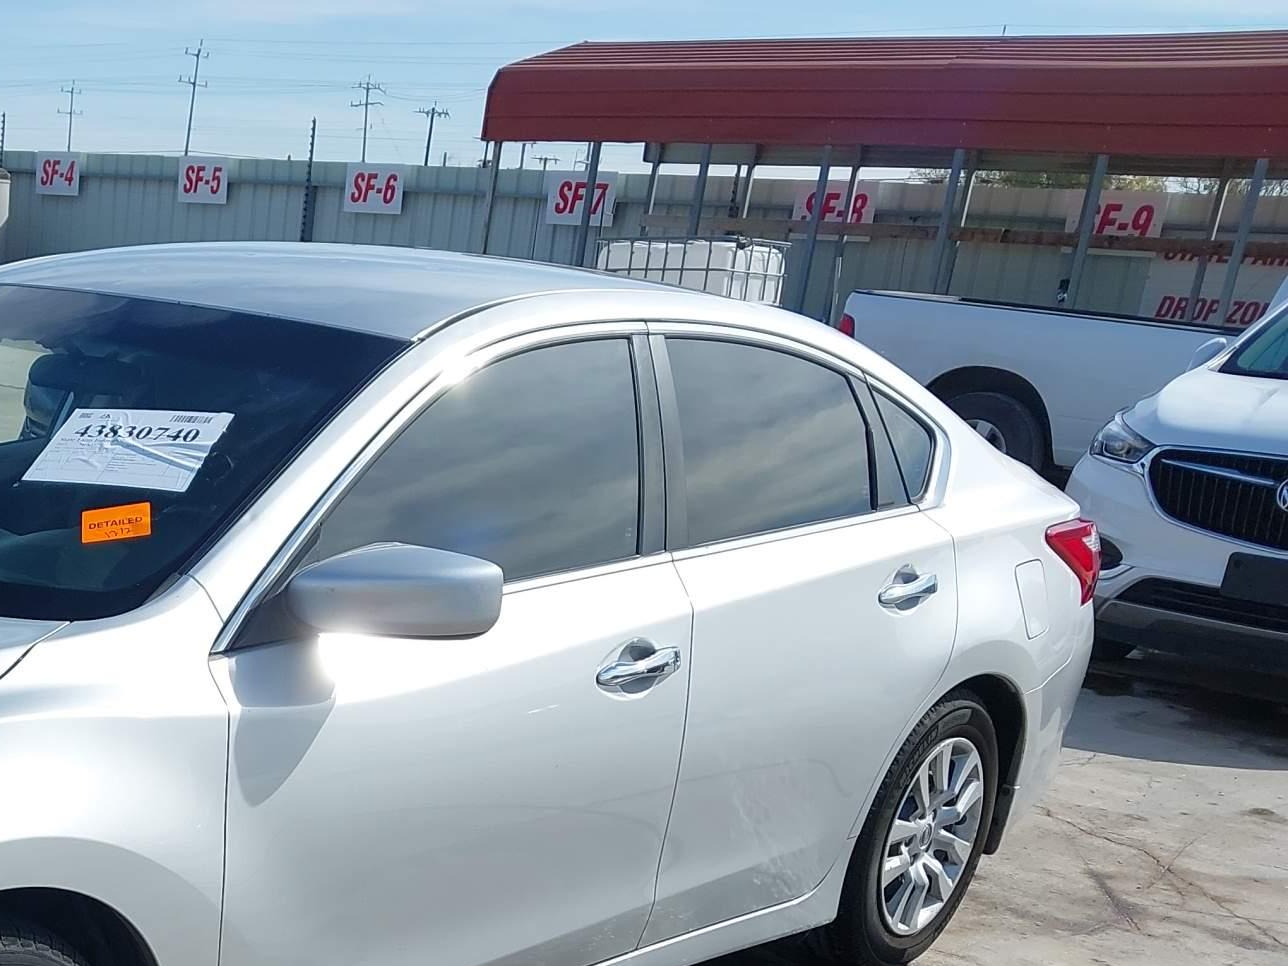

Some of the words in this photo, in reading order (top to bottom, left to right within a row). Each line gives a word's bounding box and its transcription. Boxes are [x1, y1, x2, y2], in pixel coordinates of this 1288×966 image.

[40, 158, 75, 187] SF-4
[183, 165, 223, 194] SF-5
[350, 172, 398, 204] SF-6
[554, 180, 609, 215] SF7
[1095, 202, 1155, 237] F-9
[74, 423, 200, 443] 43830740
[88, 516, 143, 530] DETAILED
